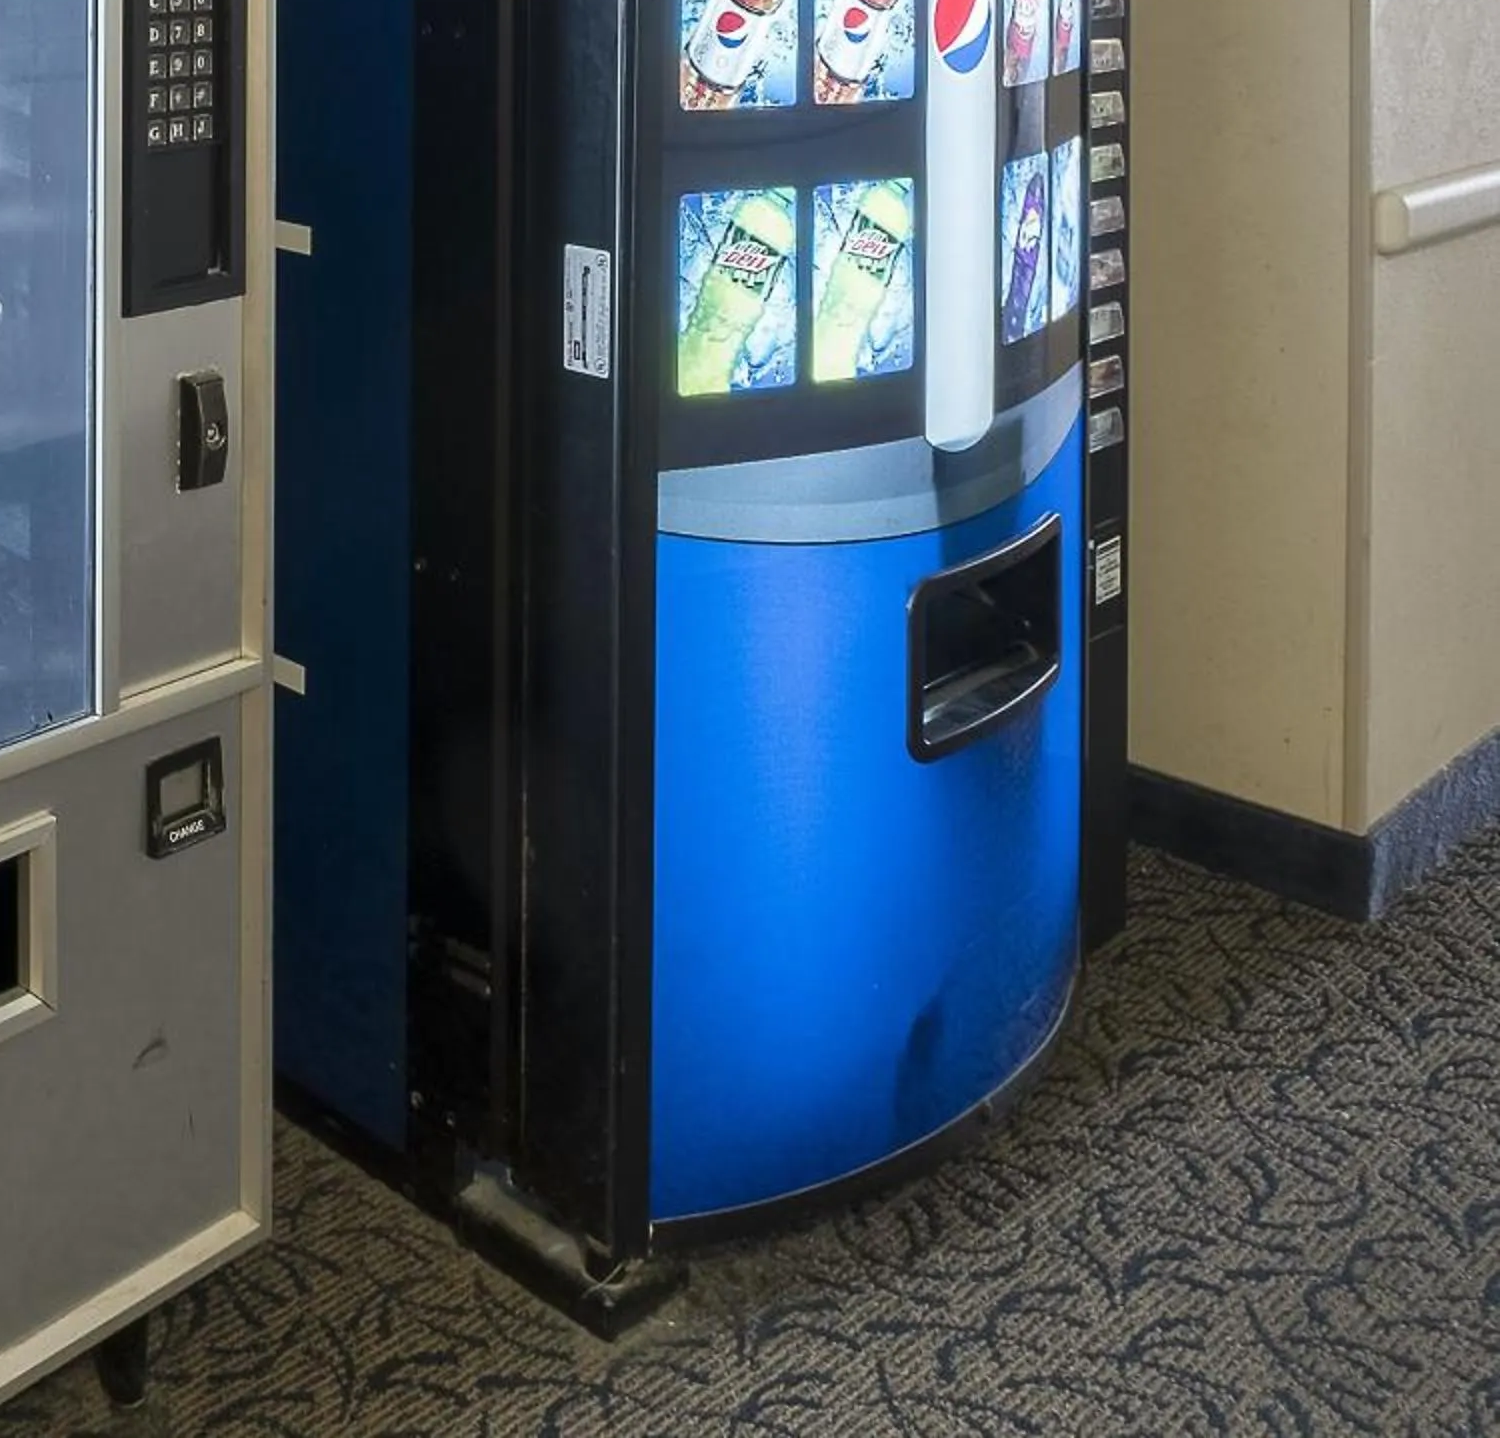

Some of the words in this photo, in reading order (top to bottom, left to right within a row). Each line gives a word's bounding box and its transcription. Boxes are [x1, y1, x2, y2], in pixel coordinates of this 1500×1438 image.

[150, 28, 160, 41] D
[174, 26, 182, 39] 7
[197, 24, 205, 37] 8
[150, 61, 160, 75] E
[174, 58, 183, 71] 9
[150, 94, 160, 107] F
[150, 127, 161, 140] G
[173, 125, 184, 138] H
[169, 820, 205, 843] CHANGE
